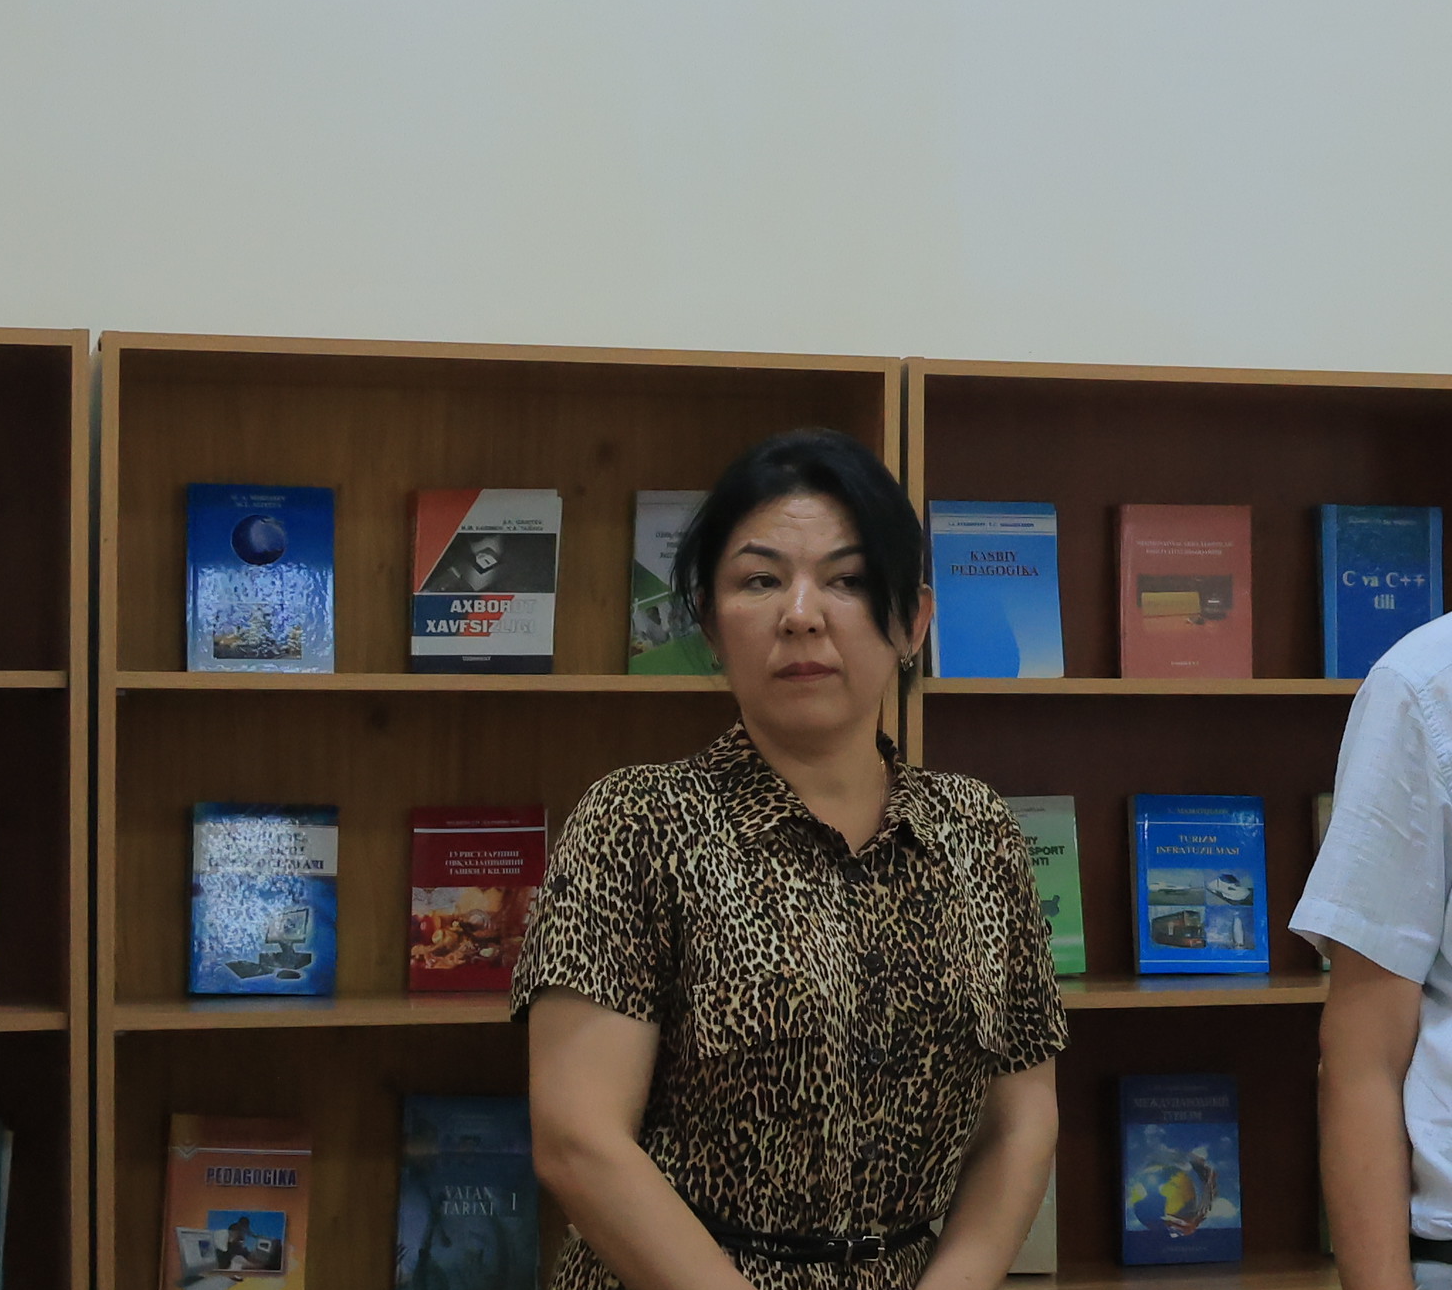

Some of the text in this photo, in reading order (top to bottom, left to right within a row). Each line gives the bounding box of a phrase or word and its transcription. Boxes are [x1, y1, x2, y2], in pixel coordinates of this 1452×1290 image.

[970, 551, 1017, 562] KASBIY
[952, 565, 1039, 576] PEDAGOGIKA
[1342, 570, 1357, 586] C
[1386, 572, 1426, 588] C++
[450, 599, 537, 614] AXBOROT
[1374, 594, 1396, 610] tili
[1179, 835, 1218, 843] TURIZM
[1028, 846, 1065, 856] SPORT
[1032, 857, 1049, 867] NTI
[206, 1166, 298, 1187] PEDAGOGIKA
